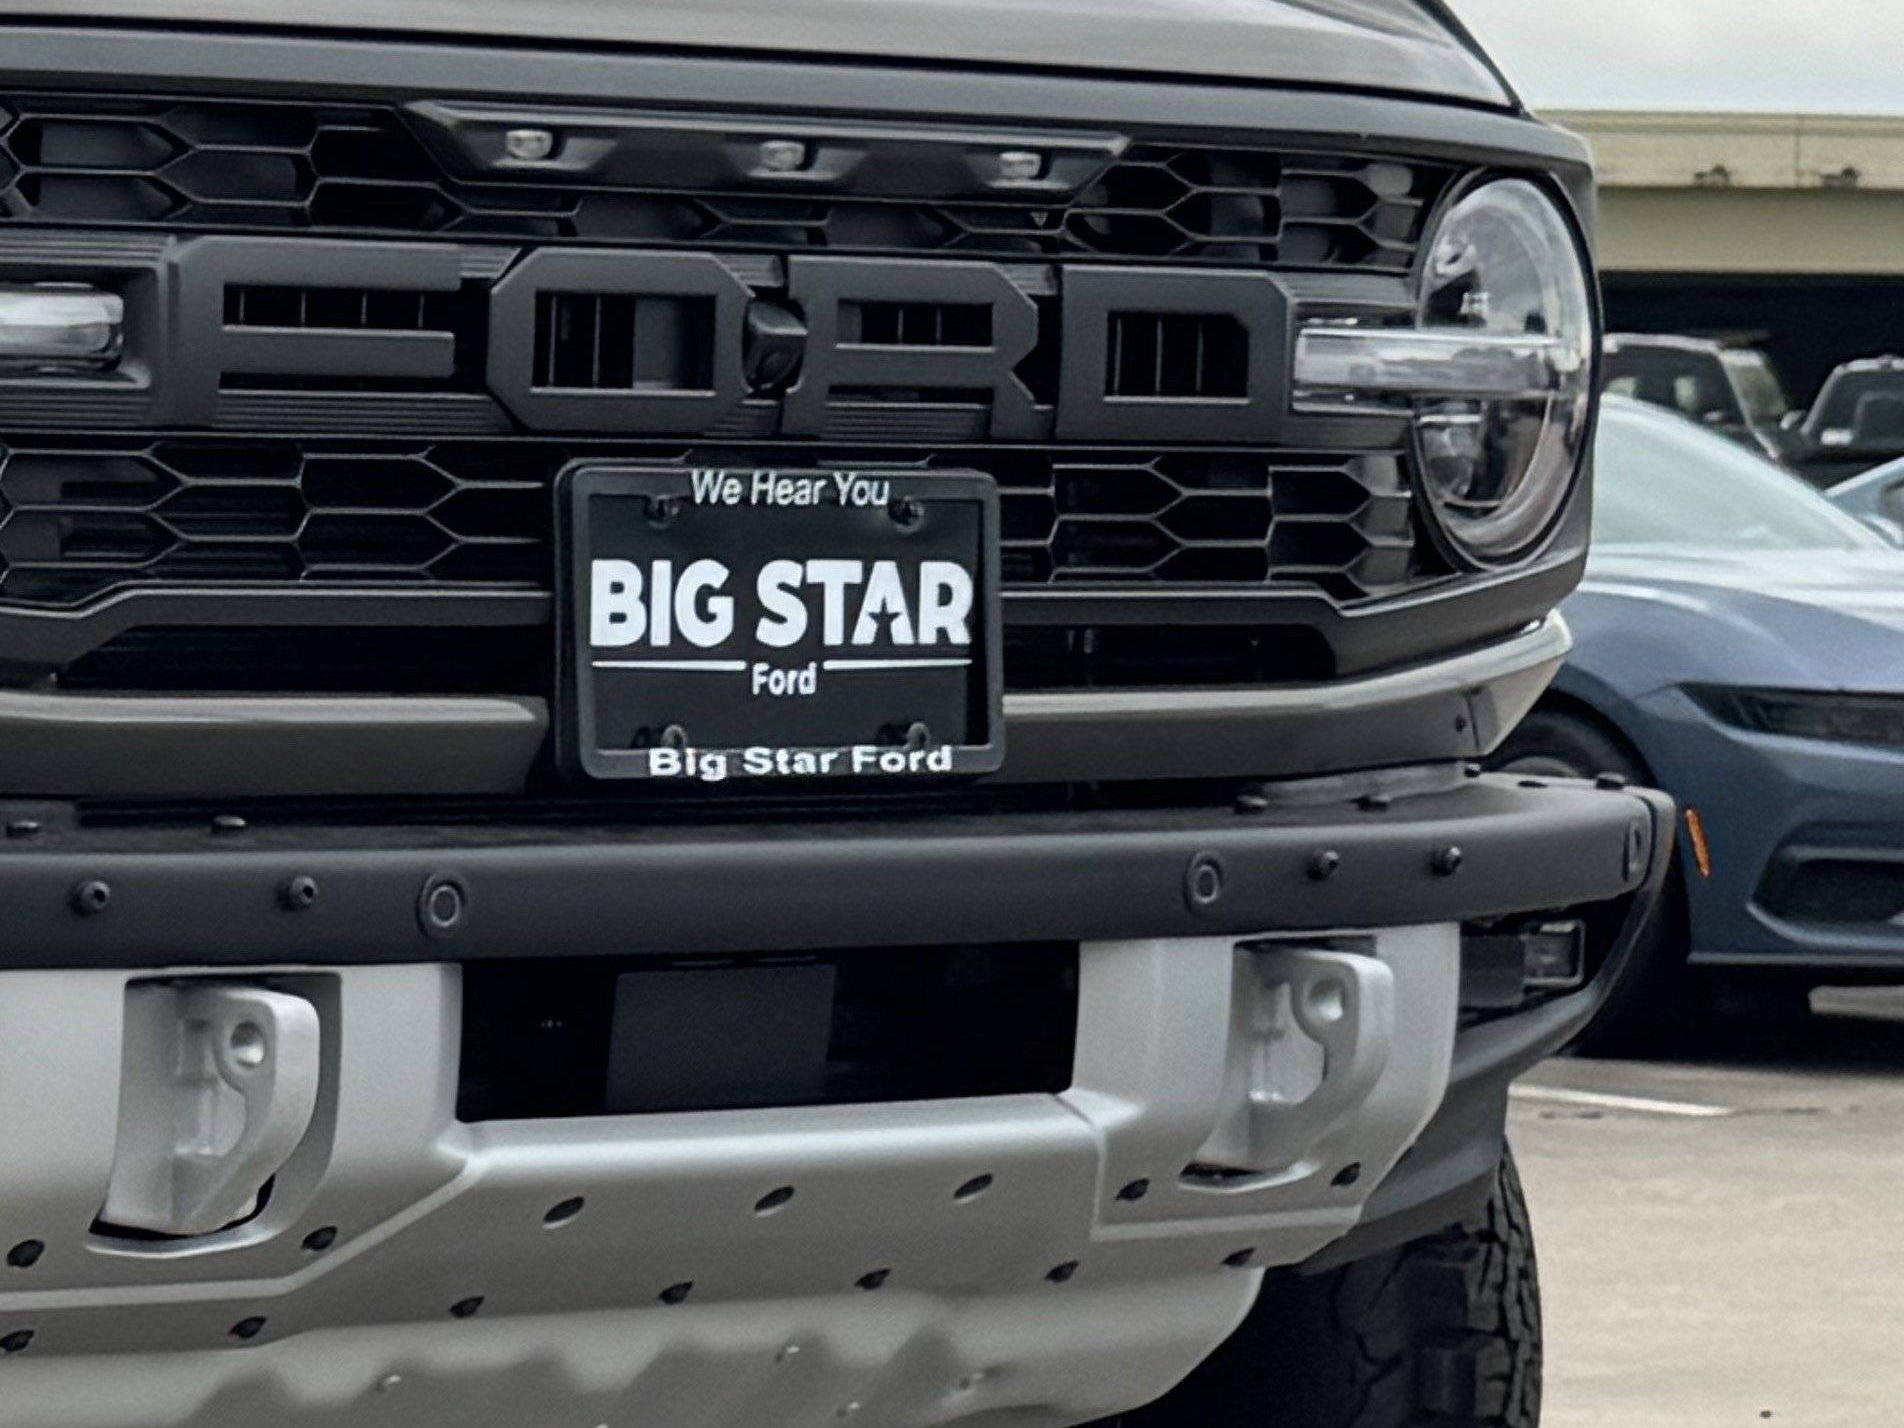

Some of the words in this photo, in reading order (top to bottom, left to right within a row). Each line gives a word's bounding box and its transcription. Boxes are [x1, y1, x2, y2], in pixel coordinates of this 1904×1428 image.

[168, 236, 1294, 440] FORD
[691, 469, 741, 506] We
[751, 472, 826, 506] Hear
[833, 471, 890, 506] You
[589, 558, 735, 648] BIG
[754, 558, 974, 647] STAR
[751, 661, 817, 695] Ford
[648, 746, 727, 781] Big
[742, 745, 839, 775] Star
[851, 744, 953, 773] Ford
